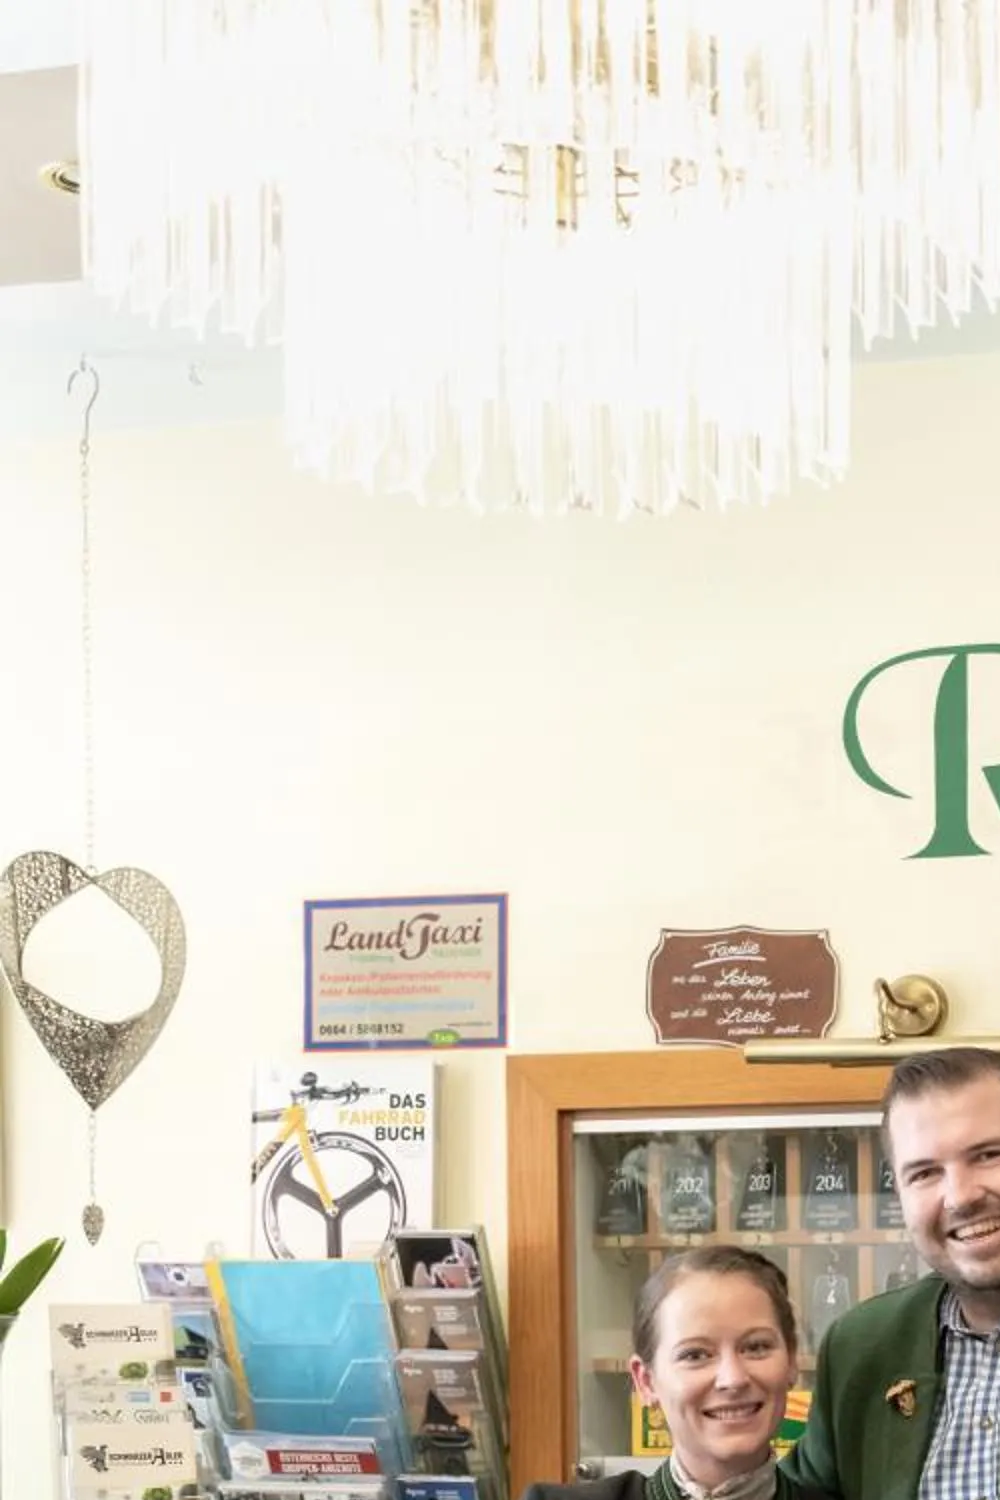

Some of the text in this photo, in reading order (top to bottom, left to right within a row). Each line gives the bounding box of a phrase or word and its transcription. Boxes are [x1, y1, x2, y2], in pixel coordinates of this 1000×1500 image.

[703, 937, 761, 957] Familie
[713, 968, 772, 988] Leben
[715, 1007, 777, 1025] Liebe
[319, 1024, 346, 1035] 0664
[389, 1093, 427, 1109] DAS
[339, 1109, 427, 1125] FAHRRAD
[374, 1126, 426, 1141] BUCH
[675, 1174, 704, 1193] 202
[748, 1173, 771, 1192] 203
[814, 1173, 844, 1191] 204
